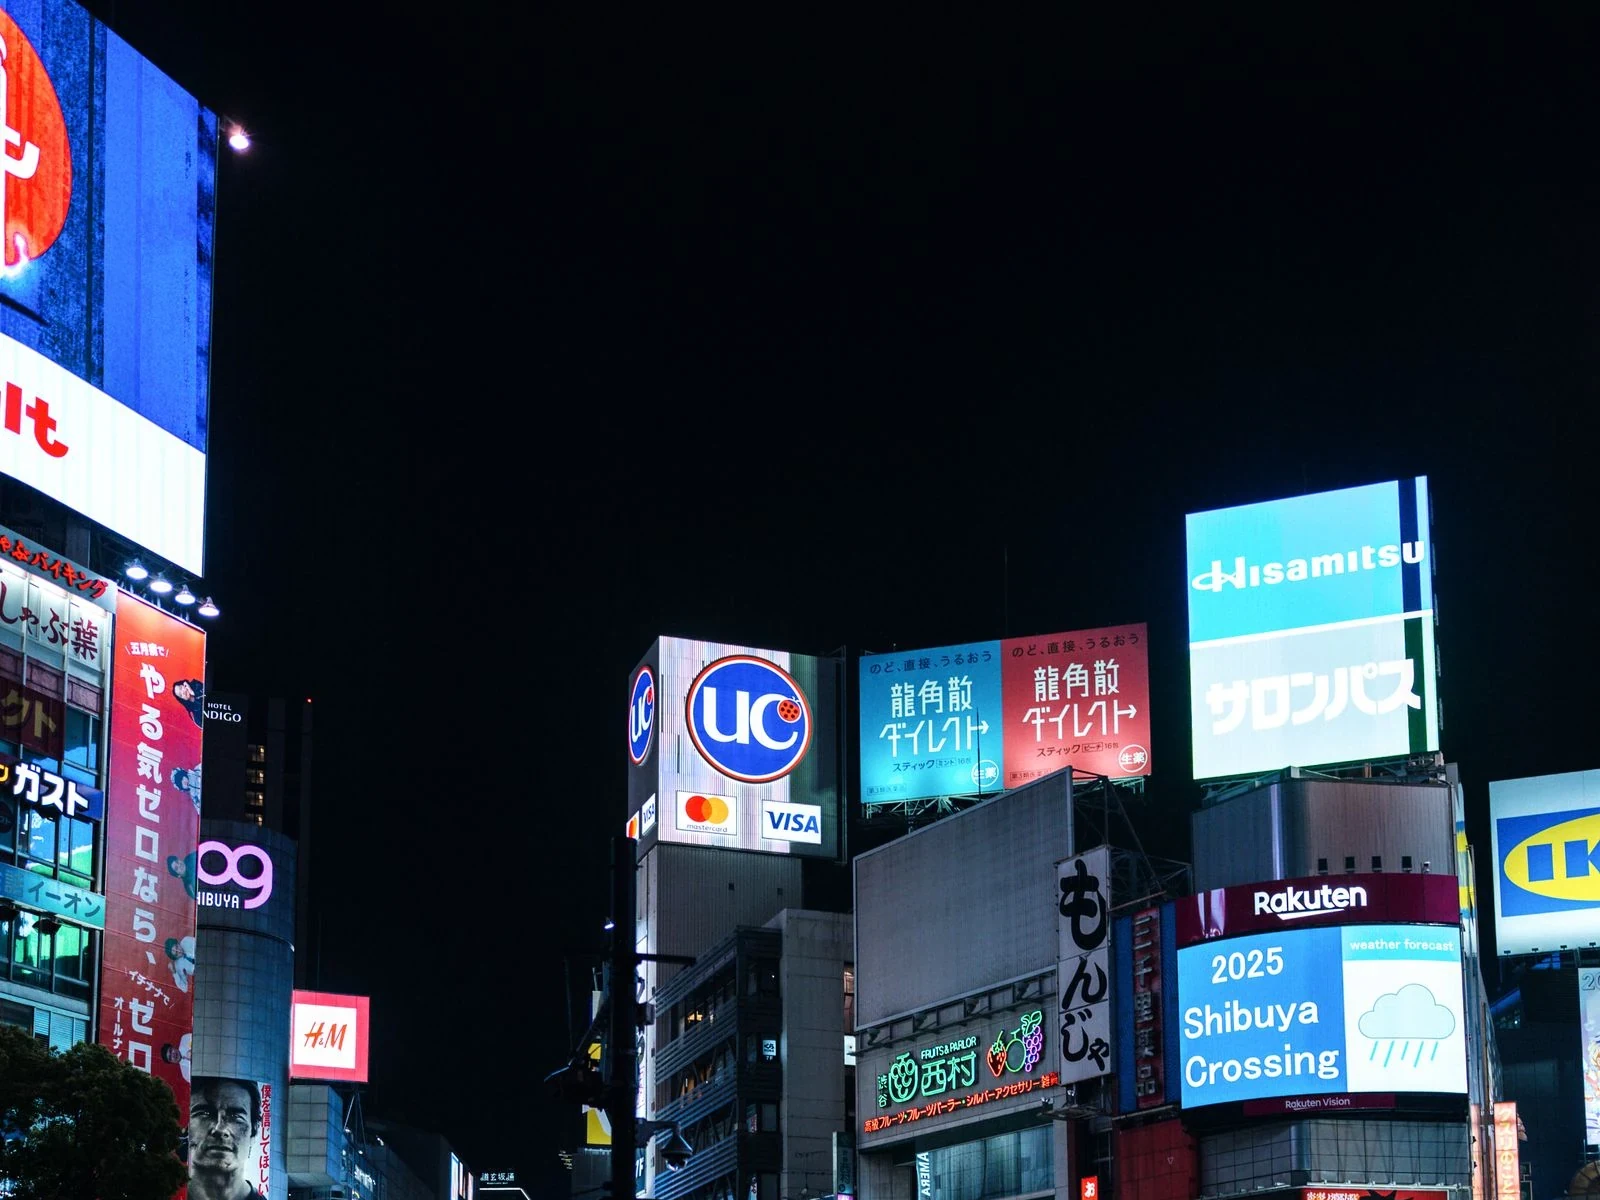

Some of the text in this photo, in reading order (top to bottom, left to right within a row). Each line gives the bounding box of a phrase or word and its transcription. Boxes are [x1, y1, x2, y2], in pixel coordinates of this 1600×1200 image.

[1192, 541, 1425, 592] Hisamitsu
[869, 650, 992, 675] のど、直接、うるおう
[1012, 633, 1140, 658] のど、直接、うるおう
[890, 674, 974, 719] 龍角散
[1034, 658, 1121, 703] 龍角散
[1205, 658, 1421, 736] サロンパス
[208, 702, 232, 711] HOTEL
[1022, 699, 1138, 743] ダイレクト
[879, 715, 990, 758] ダイレクト
[1036, 744, 1081, 758] スティック
[892, 759, 936, 773] スティック
[13, 762, 89, 817] ガスト
[686, 823, 728, 834] mastercard
[765, 810, 819, 834] VISA
[1254, 885, 1368, 920] Rakuten
[1350, 938, 1455, 952] weather forecast
[1060, 859, 1110, 1072] もんじゃ
[1211, 946, 1284, 984] 2025
[303, 1021, 347, 1050] H&M
[1184, 1000, 1320, 1040] Shibuya
[920, 1050, 976, 1097] 西村
[1185, 1043, 1340, 1088] Crossing
[877, 1075, 888, 1108] 渋谷
[1285, 1096, 1351, 1111] Rakuten Vision
[257, 1084, 272, 1196] 僕を信じてほしい
